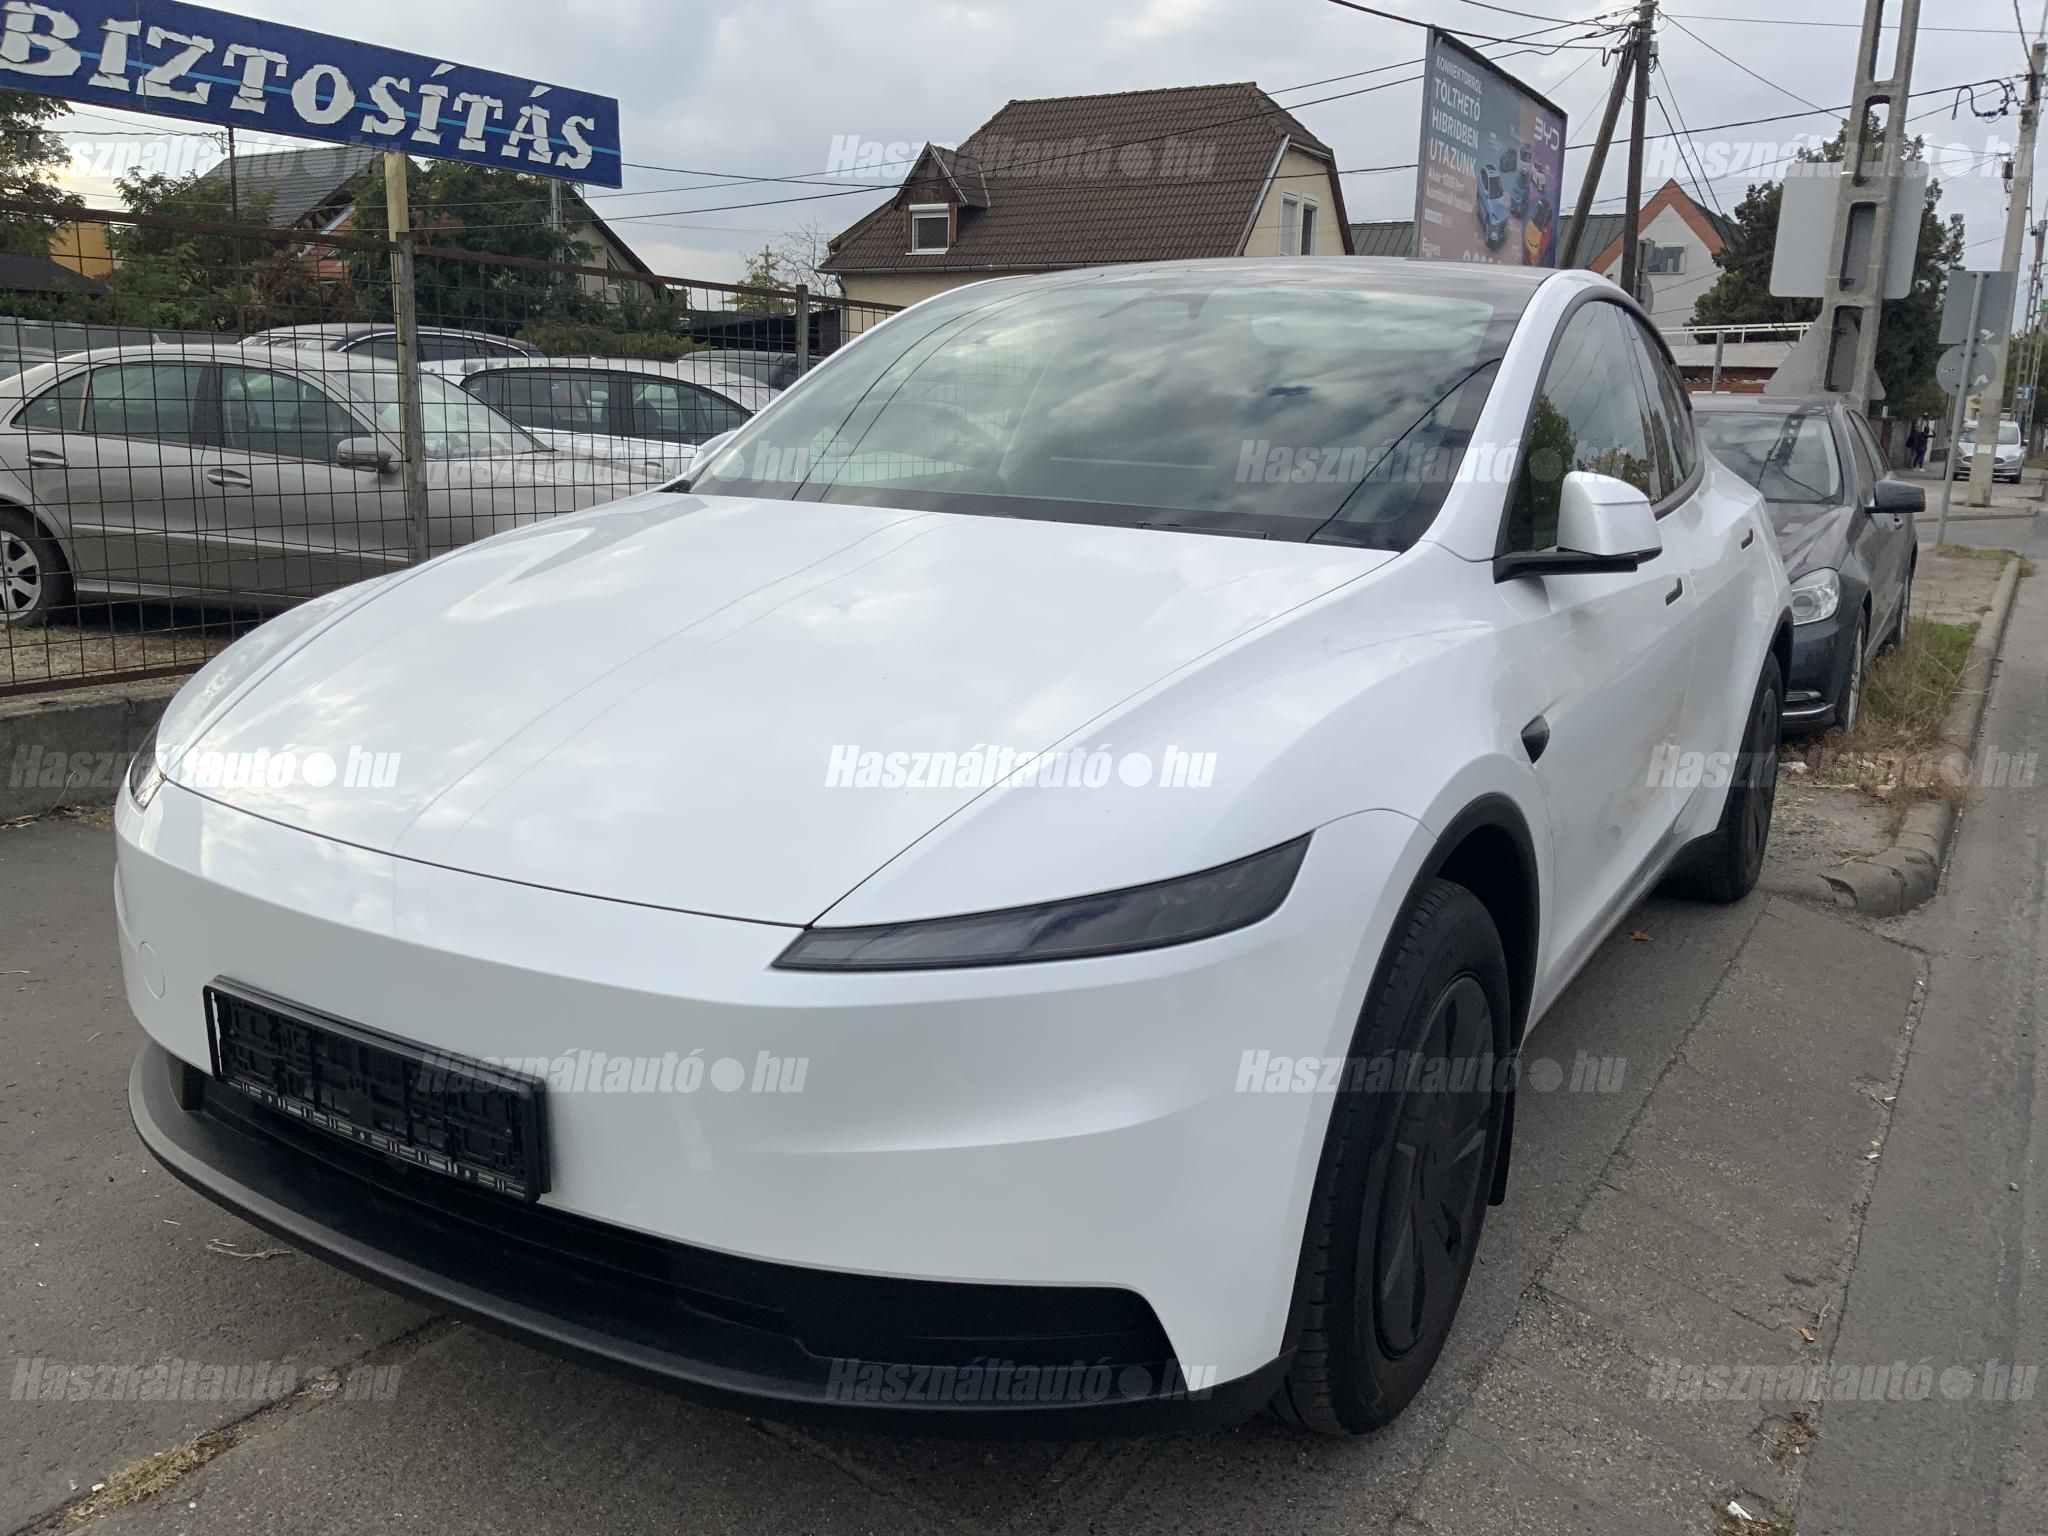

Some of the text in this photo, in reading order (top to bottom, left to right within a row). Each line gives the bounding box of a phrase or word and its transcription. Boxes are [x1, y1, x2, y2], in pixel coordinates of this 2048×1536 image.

[0, 0, 595, 170] BIZTOSÍTÁS
[1432, 107, 1479, 149] HIBRIDBEN
[1533, 116, 1560, 151] BYD
[1430, 138, 1477, 178] UTAZUNK
